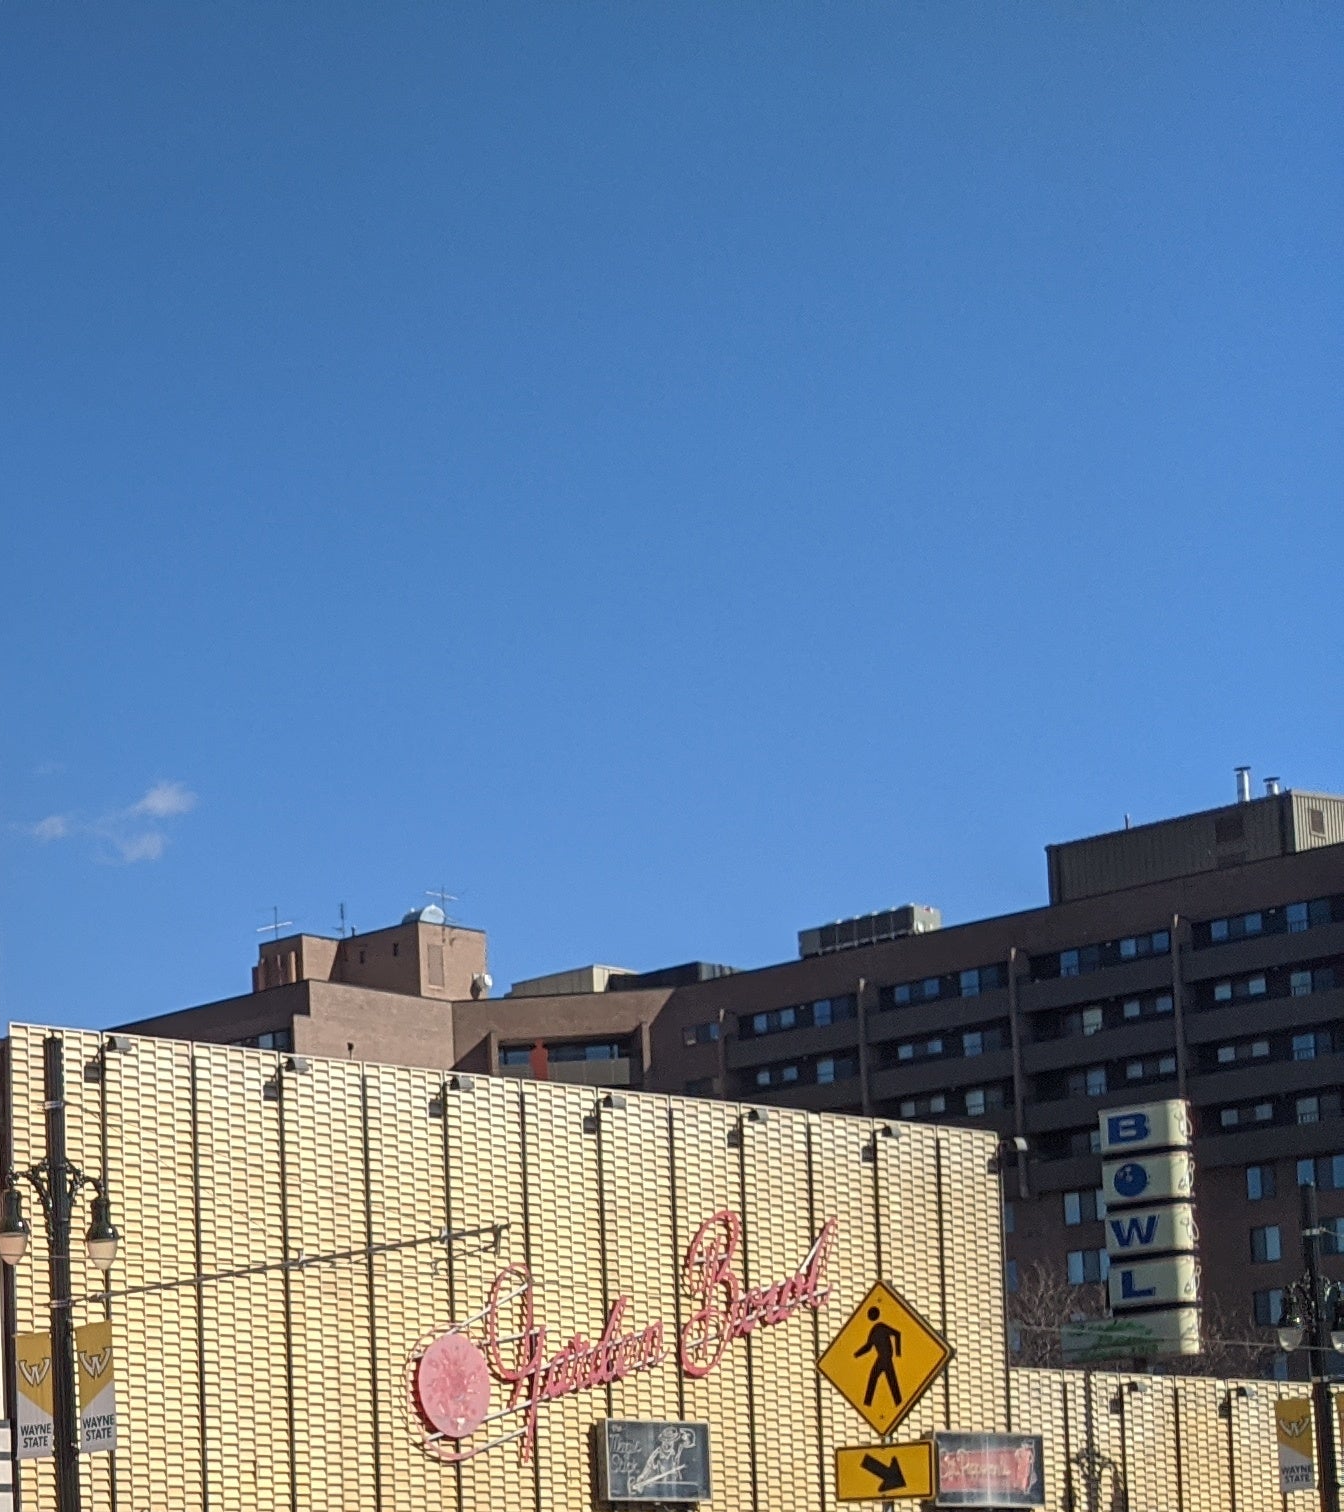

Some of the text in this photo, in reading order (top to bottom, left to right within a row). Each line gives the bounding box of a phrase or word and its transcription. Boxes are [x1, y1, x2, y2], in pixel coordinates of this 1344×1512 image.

[486, 1210, 838, 1463] Garden Bowl
[83, 1414, 114, 1430] WAYNE
[20, 1423, 51, 1436] WAYNE
[85, 1427, 112, 1441] STATE
[23, 1436, 48, 1448] STATE
